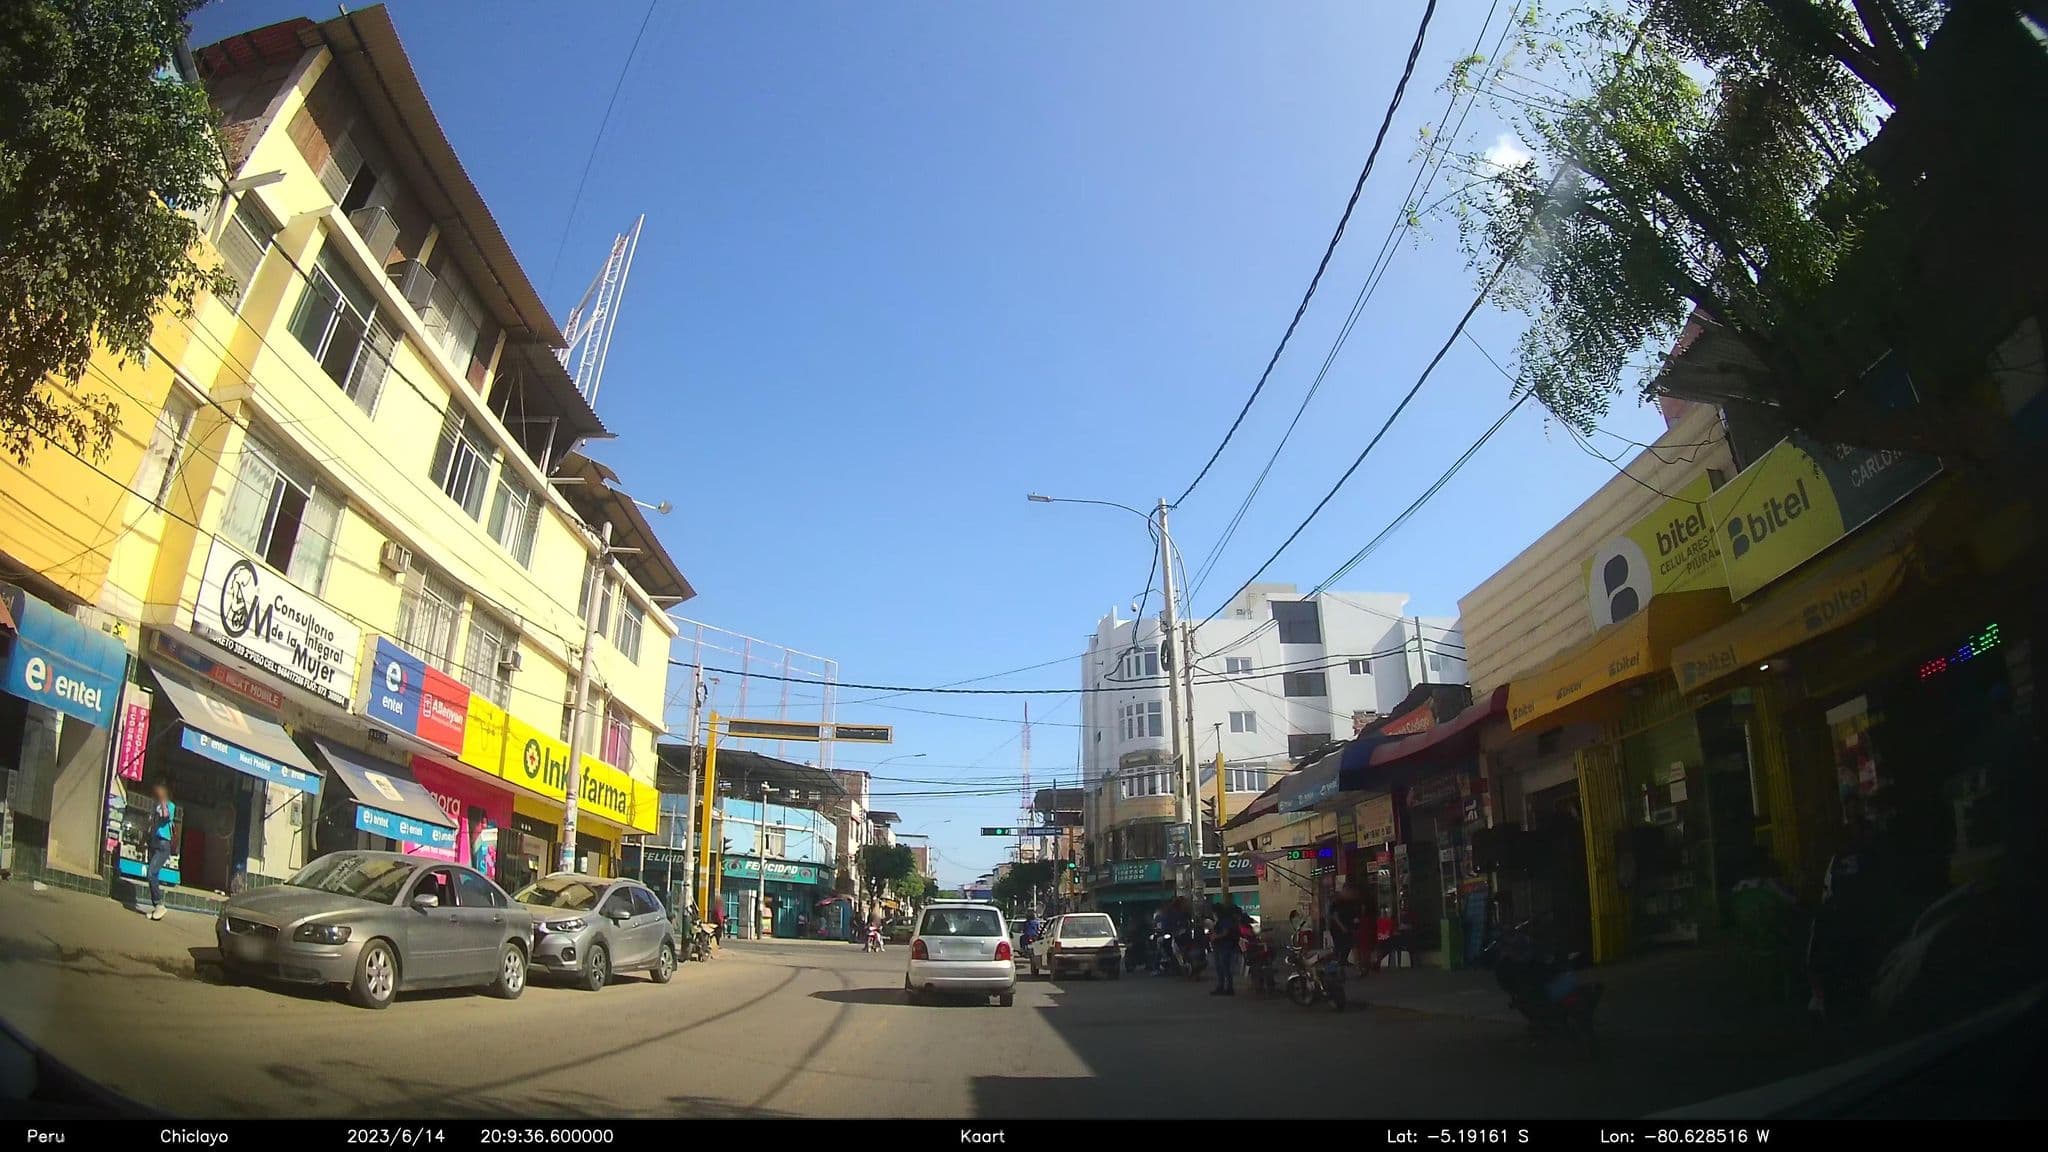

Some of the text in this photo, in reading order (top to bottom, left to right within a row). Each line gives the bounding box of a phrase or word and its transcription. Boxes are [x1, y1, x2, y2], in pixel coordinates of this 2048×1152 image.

[1656, 504, 1707, 556] bitel
[1749, 478, 1811, 548] bitel
[271, 624, 284, 640] de
[287, 631, 298, 648] la
[274, 595, 334, 642] Consultorio
[292, 644, 335, 683] Mujer
[55, 675, 102, 712] entel
[382, 695, 404, 715] entel
[543, 747, 626, 815] Inkfarma
[643, 851, 699, 865] FELICIDD
